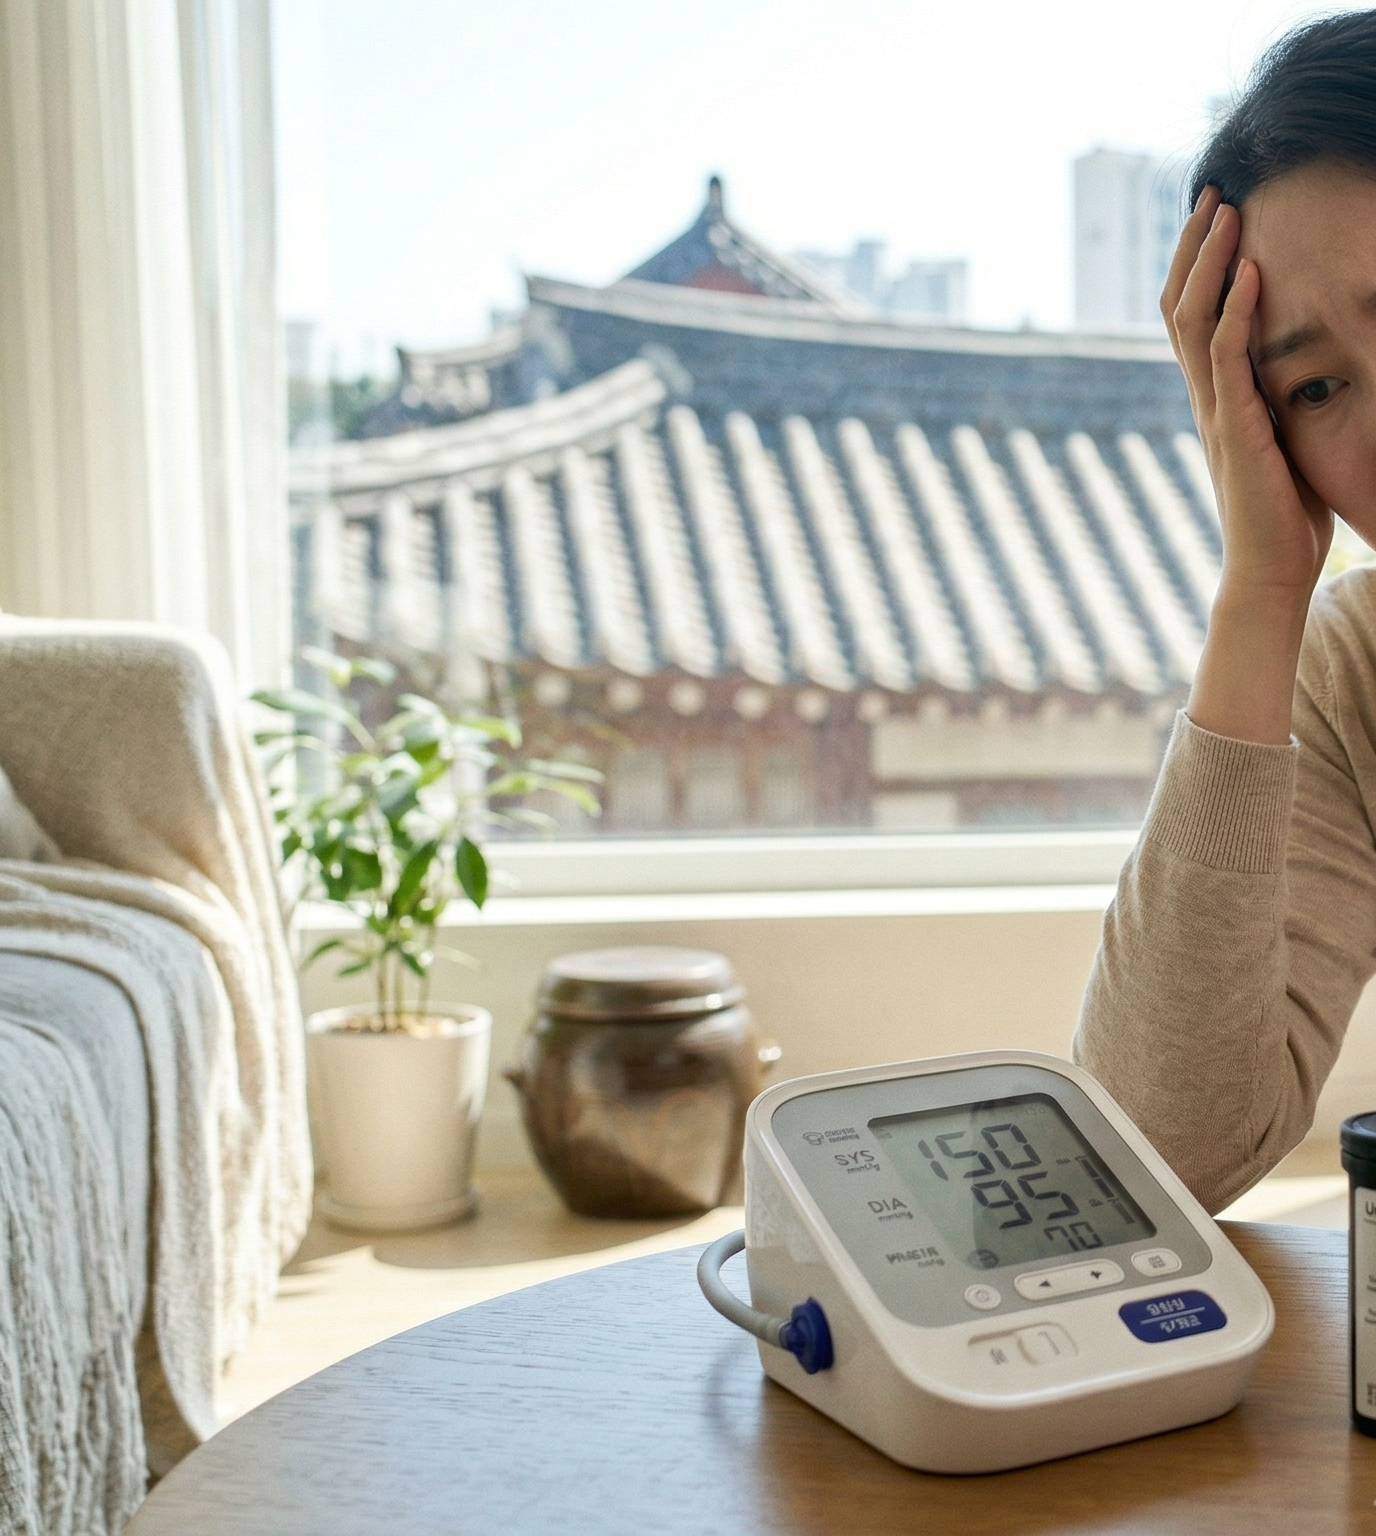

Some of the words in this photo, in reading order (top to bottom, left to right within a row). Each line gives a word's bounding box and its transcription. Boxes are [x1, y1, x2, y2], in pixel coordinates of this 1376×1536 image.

[834, 1150, 875, 1166] SYS
[917, 1123, 1042, 1182] 150
[867, 1197, 908, 1214] DIA
[970, 1171, 1080, 1230] 95
[1043, 1221, 1103, 1252] 70
